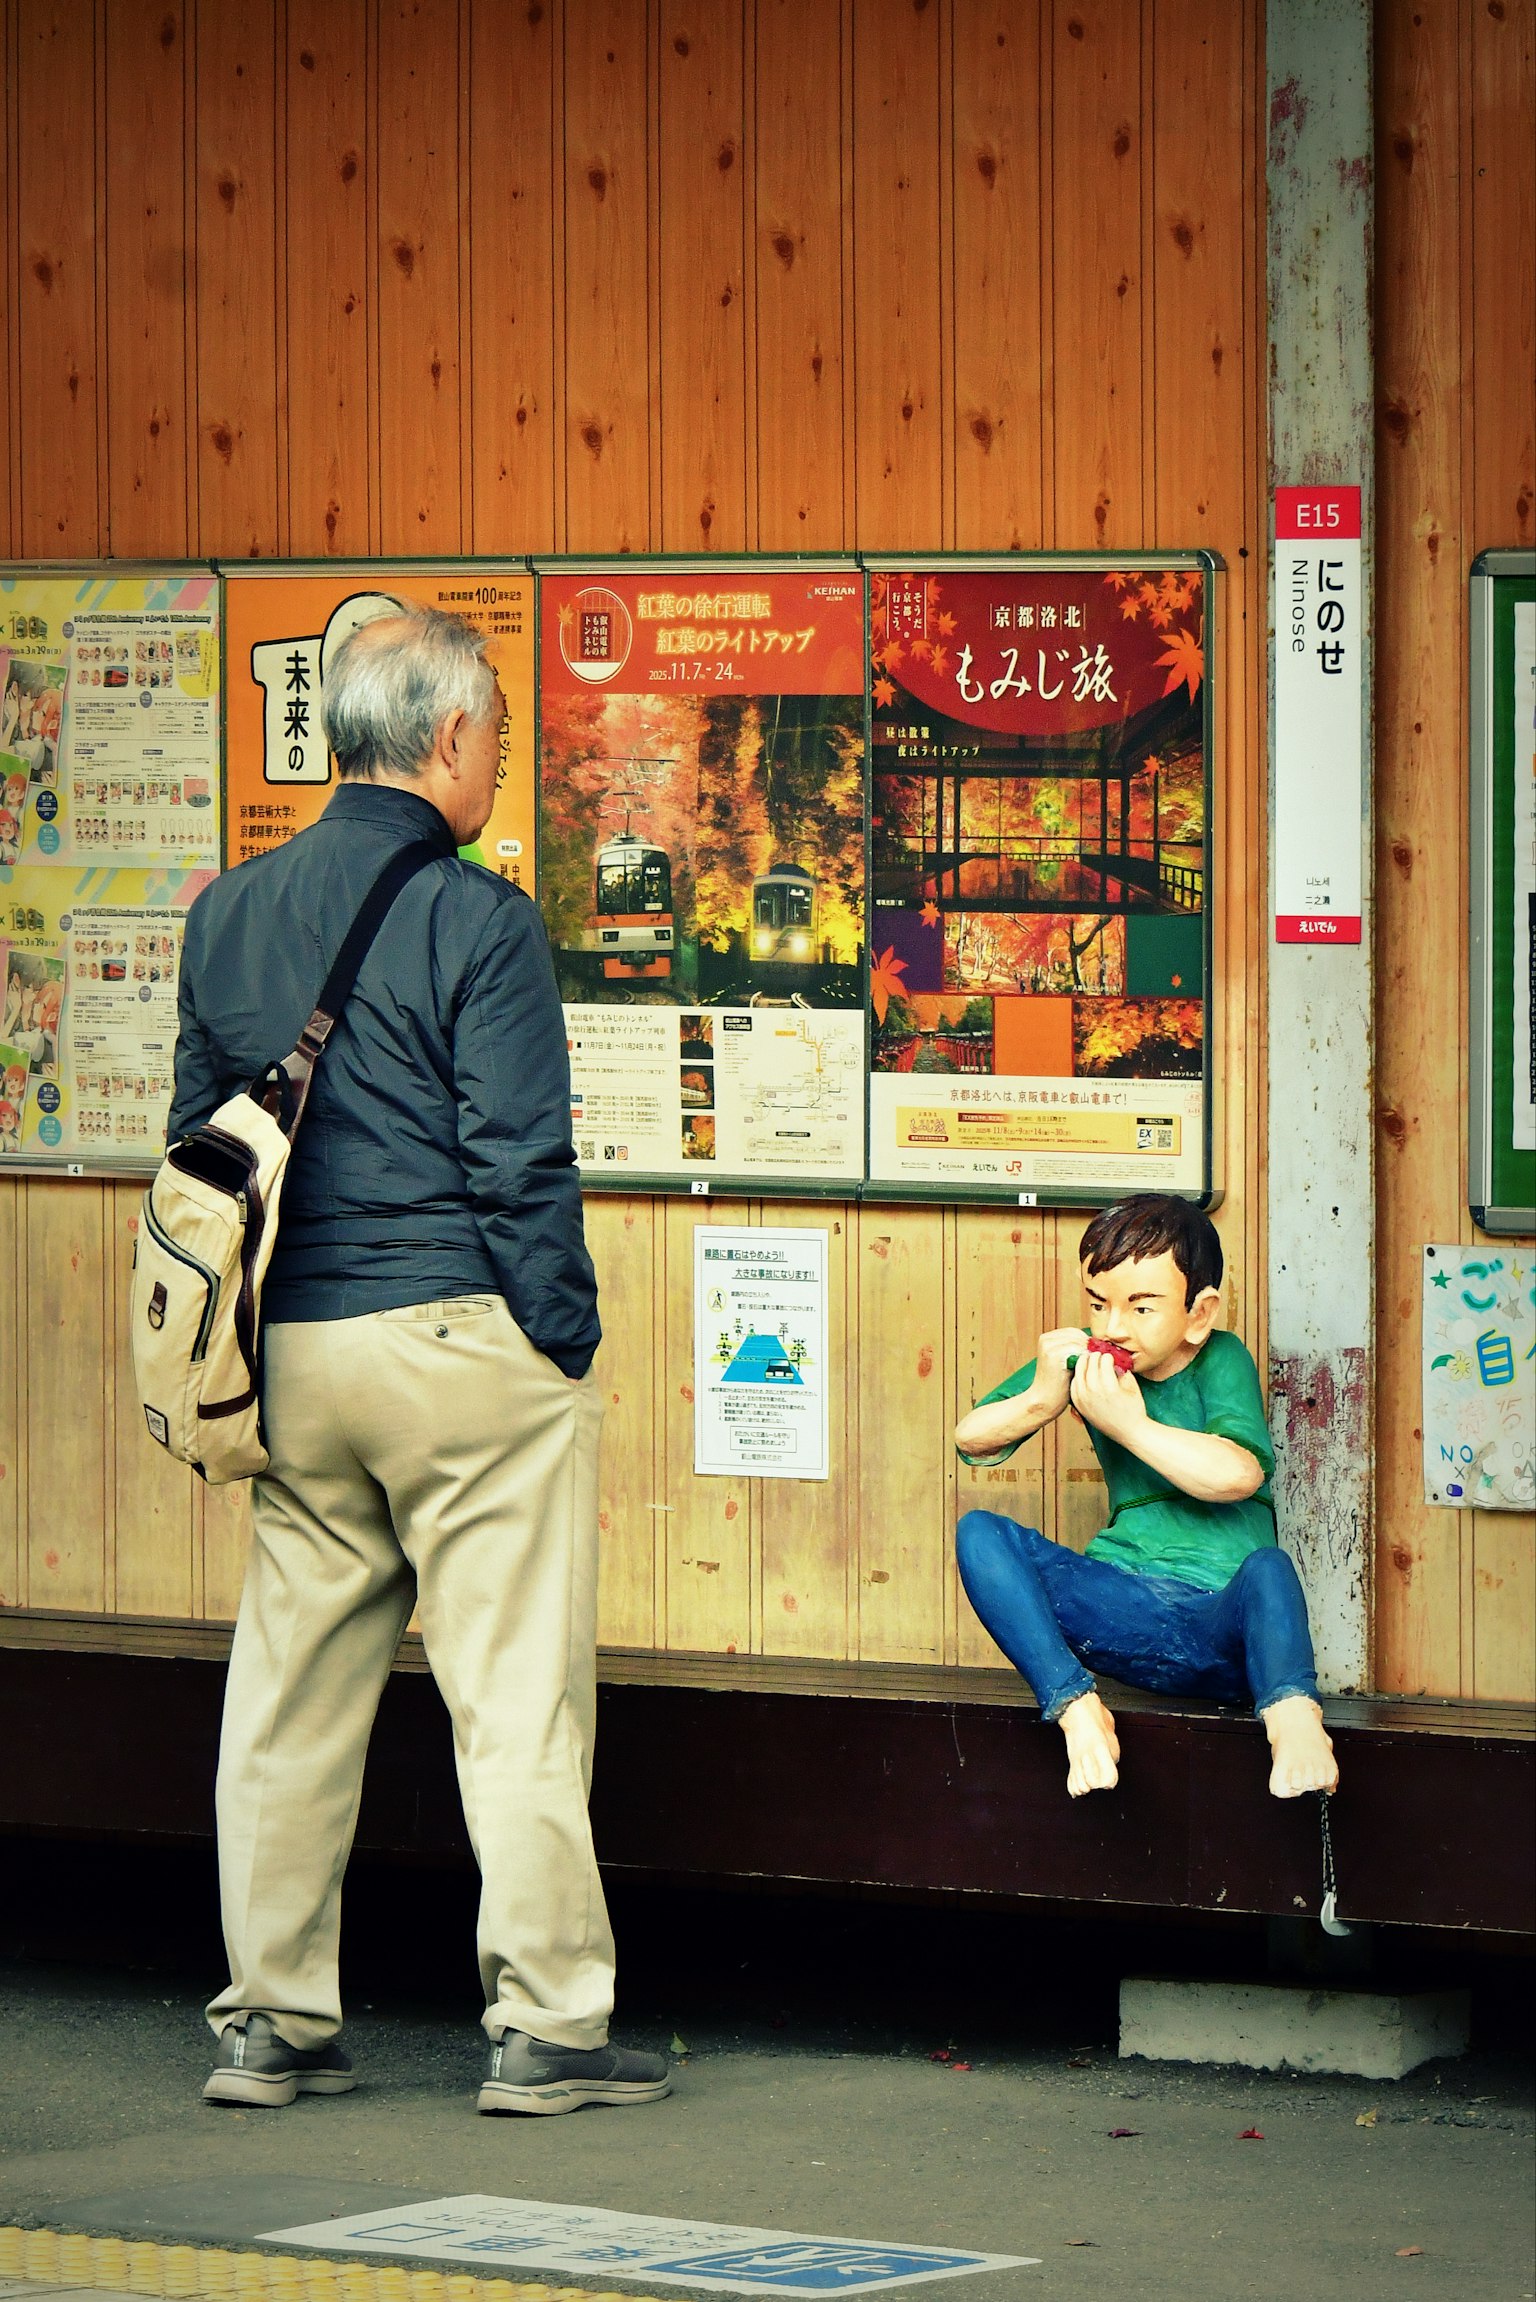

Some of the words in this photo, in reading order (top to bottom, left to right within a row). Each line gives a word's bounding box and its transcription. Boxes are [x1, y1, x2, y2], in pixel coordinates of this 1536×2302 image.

[1297, 503, 1340, 528] E15
[814, 587, 856, 596] KEIHAN
[637, 594, 771, 619] 紅葉の徐行運転
[913, 592, 922, 629] そうだ
[1292, 560, 1308, 653] Ninose
[993, 605, 1082, 628] 京都洛北
[1316, 559, 1345, 675] にのせ
[584, 615, 592, 656] トンネル
[592, 615, 600, 656] もみじの
[657, 627, 815, 655] 紅葉のライトアップ
[955, 642, 1118, 702] もみじ旅
[284, 650, 311, 772] 未来の
[898, 745, 980, 757] 夜はライトアップ
[239, 805, 297, 819] 京都芸術大学と
[239, 825, 297, 839] 京都精華大学の
[1306, 876, 1330, 887] 니노세
[1299, 921, 1337, 933] えいでん
[1139, 1128, 1152, 1138] EX
[73, 1166, 79, 1174] 4
[973, 1163, 998, 1172] えいでん
[1005, 1160, 1021, 1172] JR
[697, 1183, 703, 1193] 2
[1025, 1195, 1031, 1204] 1
[735, 1268, 815, 1281] 大きな事故になります!!
[1440, 1443, 1474, 1464] NO
[424, 2212, 534, 2230] Point
[345, 2222, 680, 2263] 乗車口
[540, 2226, 727, 2250] Boarding
